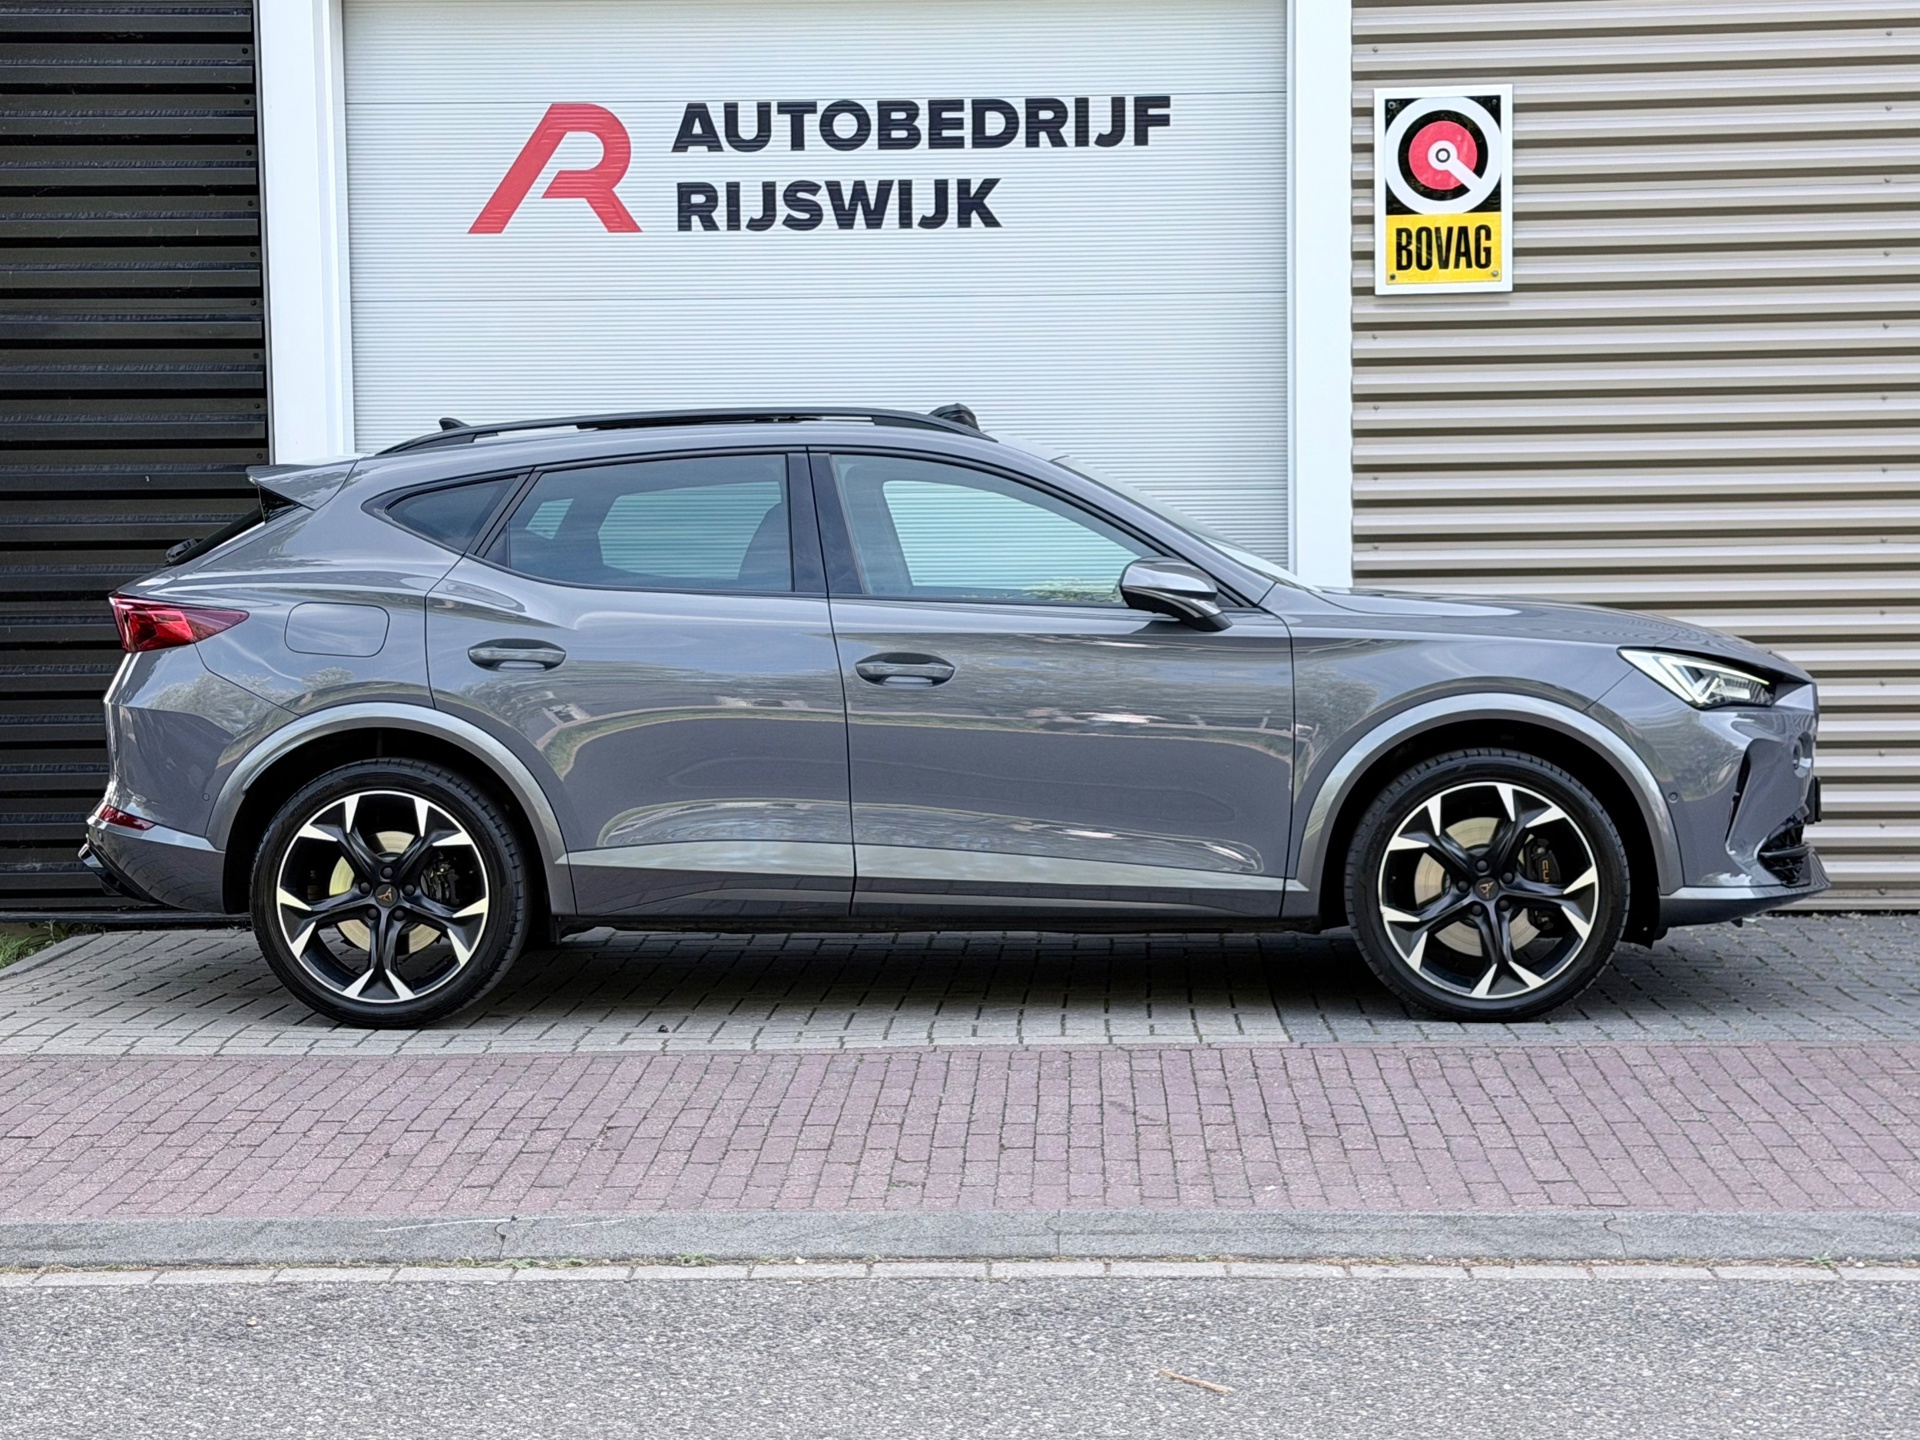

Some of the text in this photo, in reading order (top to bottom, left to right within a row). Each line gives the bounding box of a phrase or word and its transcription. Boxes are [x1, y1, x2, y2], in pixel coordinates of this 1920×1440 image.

[672, 95, 1170, 153] AUTOBEDRIJF
[677, 178, 1002, 232] RIJSWIJK
[1395, 224, 1492, 271] BOVAG
